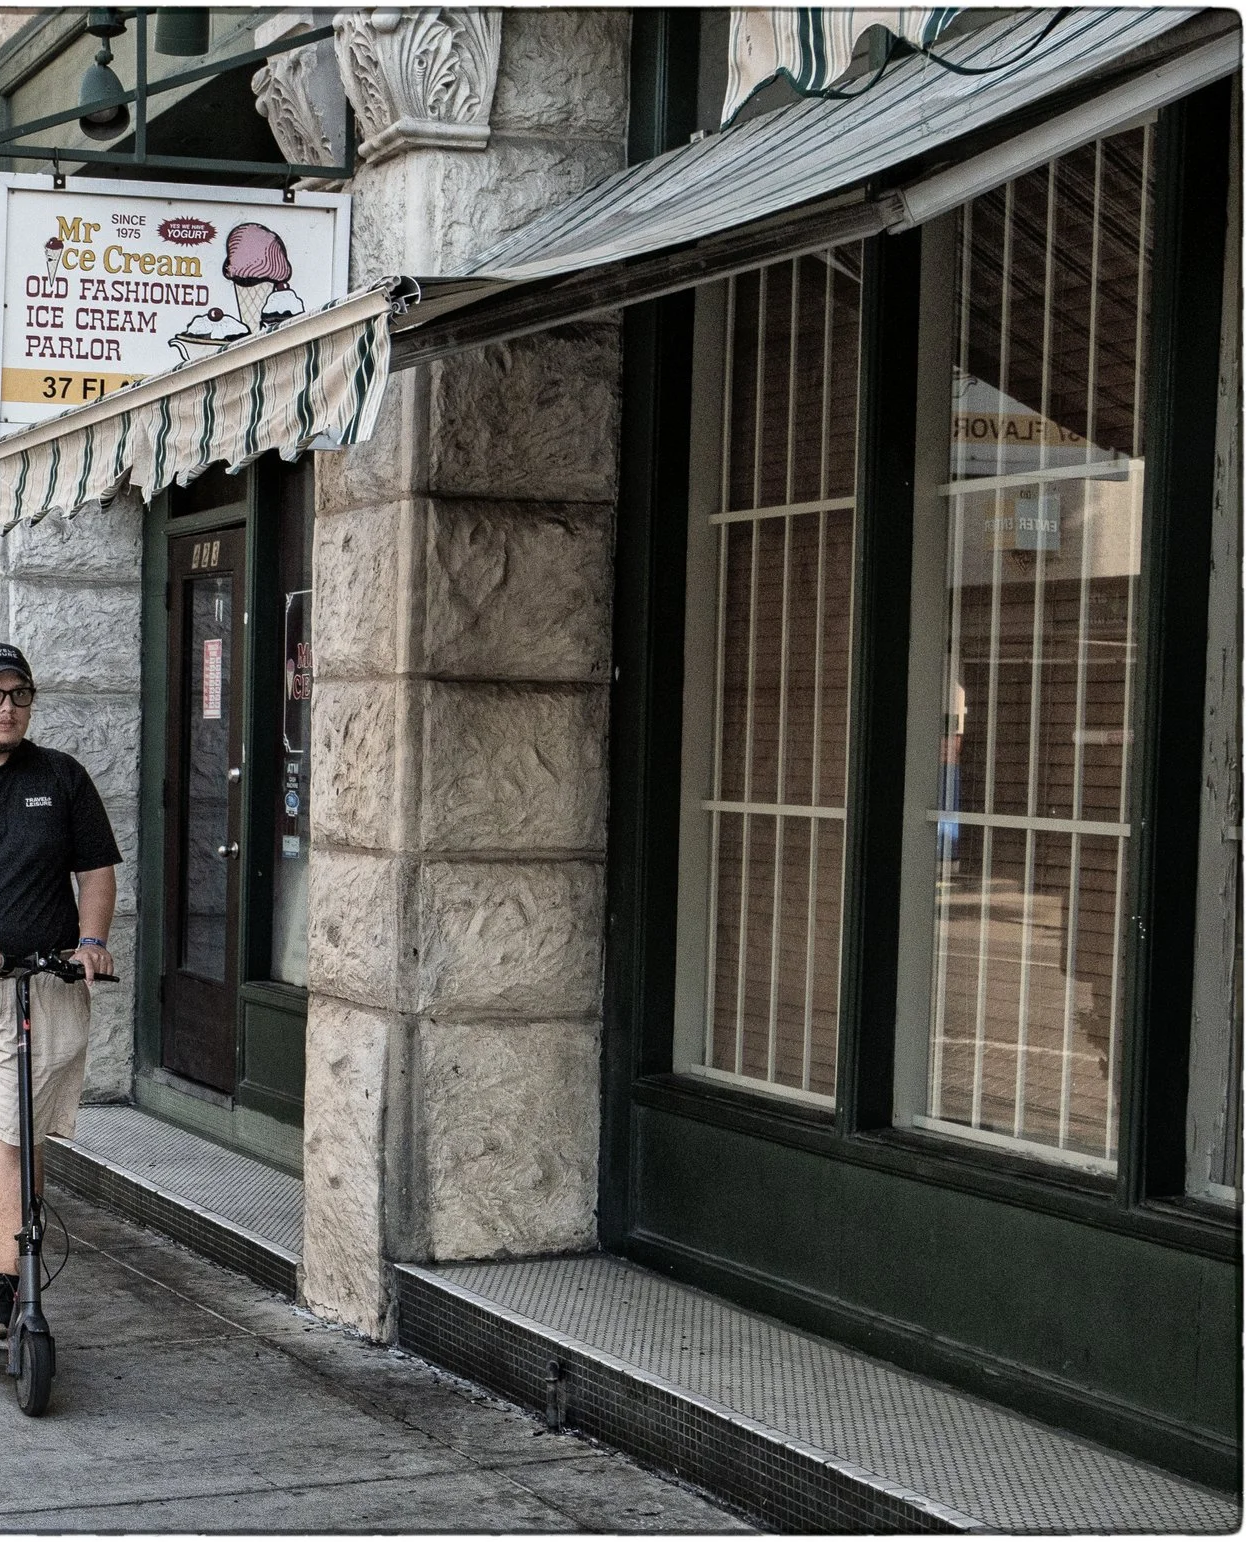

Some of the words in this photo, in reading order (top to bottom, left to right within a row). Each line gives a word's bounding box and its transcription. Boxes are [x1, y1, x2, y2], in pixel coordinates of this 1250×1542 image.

[56, 215, 101, 243] Mr
[111, 213, 146, 226] SINCE
[116, 227, 141, 239] 1975
[167, 229, 209, 239] YOGURT
[103, 245, 203, 277] Cream
[26, 275, 69, 299] OLD
[79, 278, 209, 306] FASHIONED
[26, 305, 64, 328] ICE
[75, 308, 157, 333] CREAM
[25, 335, 122, 361] PARLOR
[43, 376, 73, 399] 37
